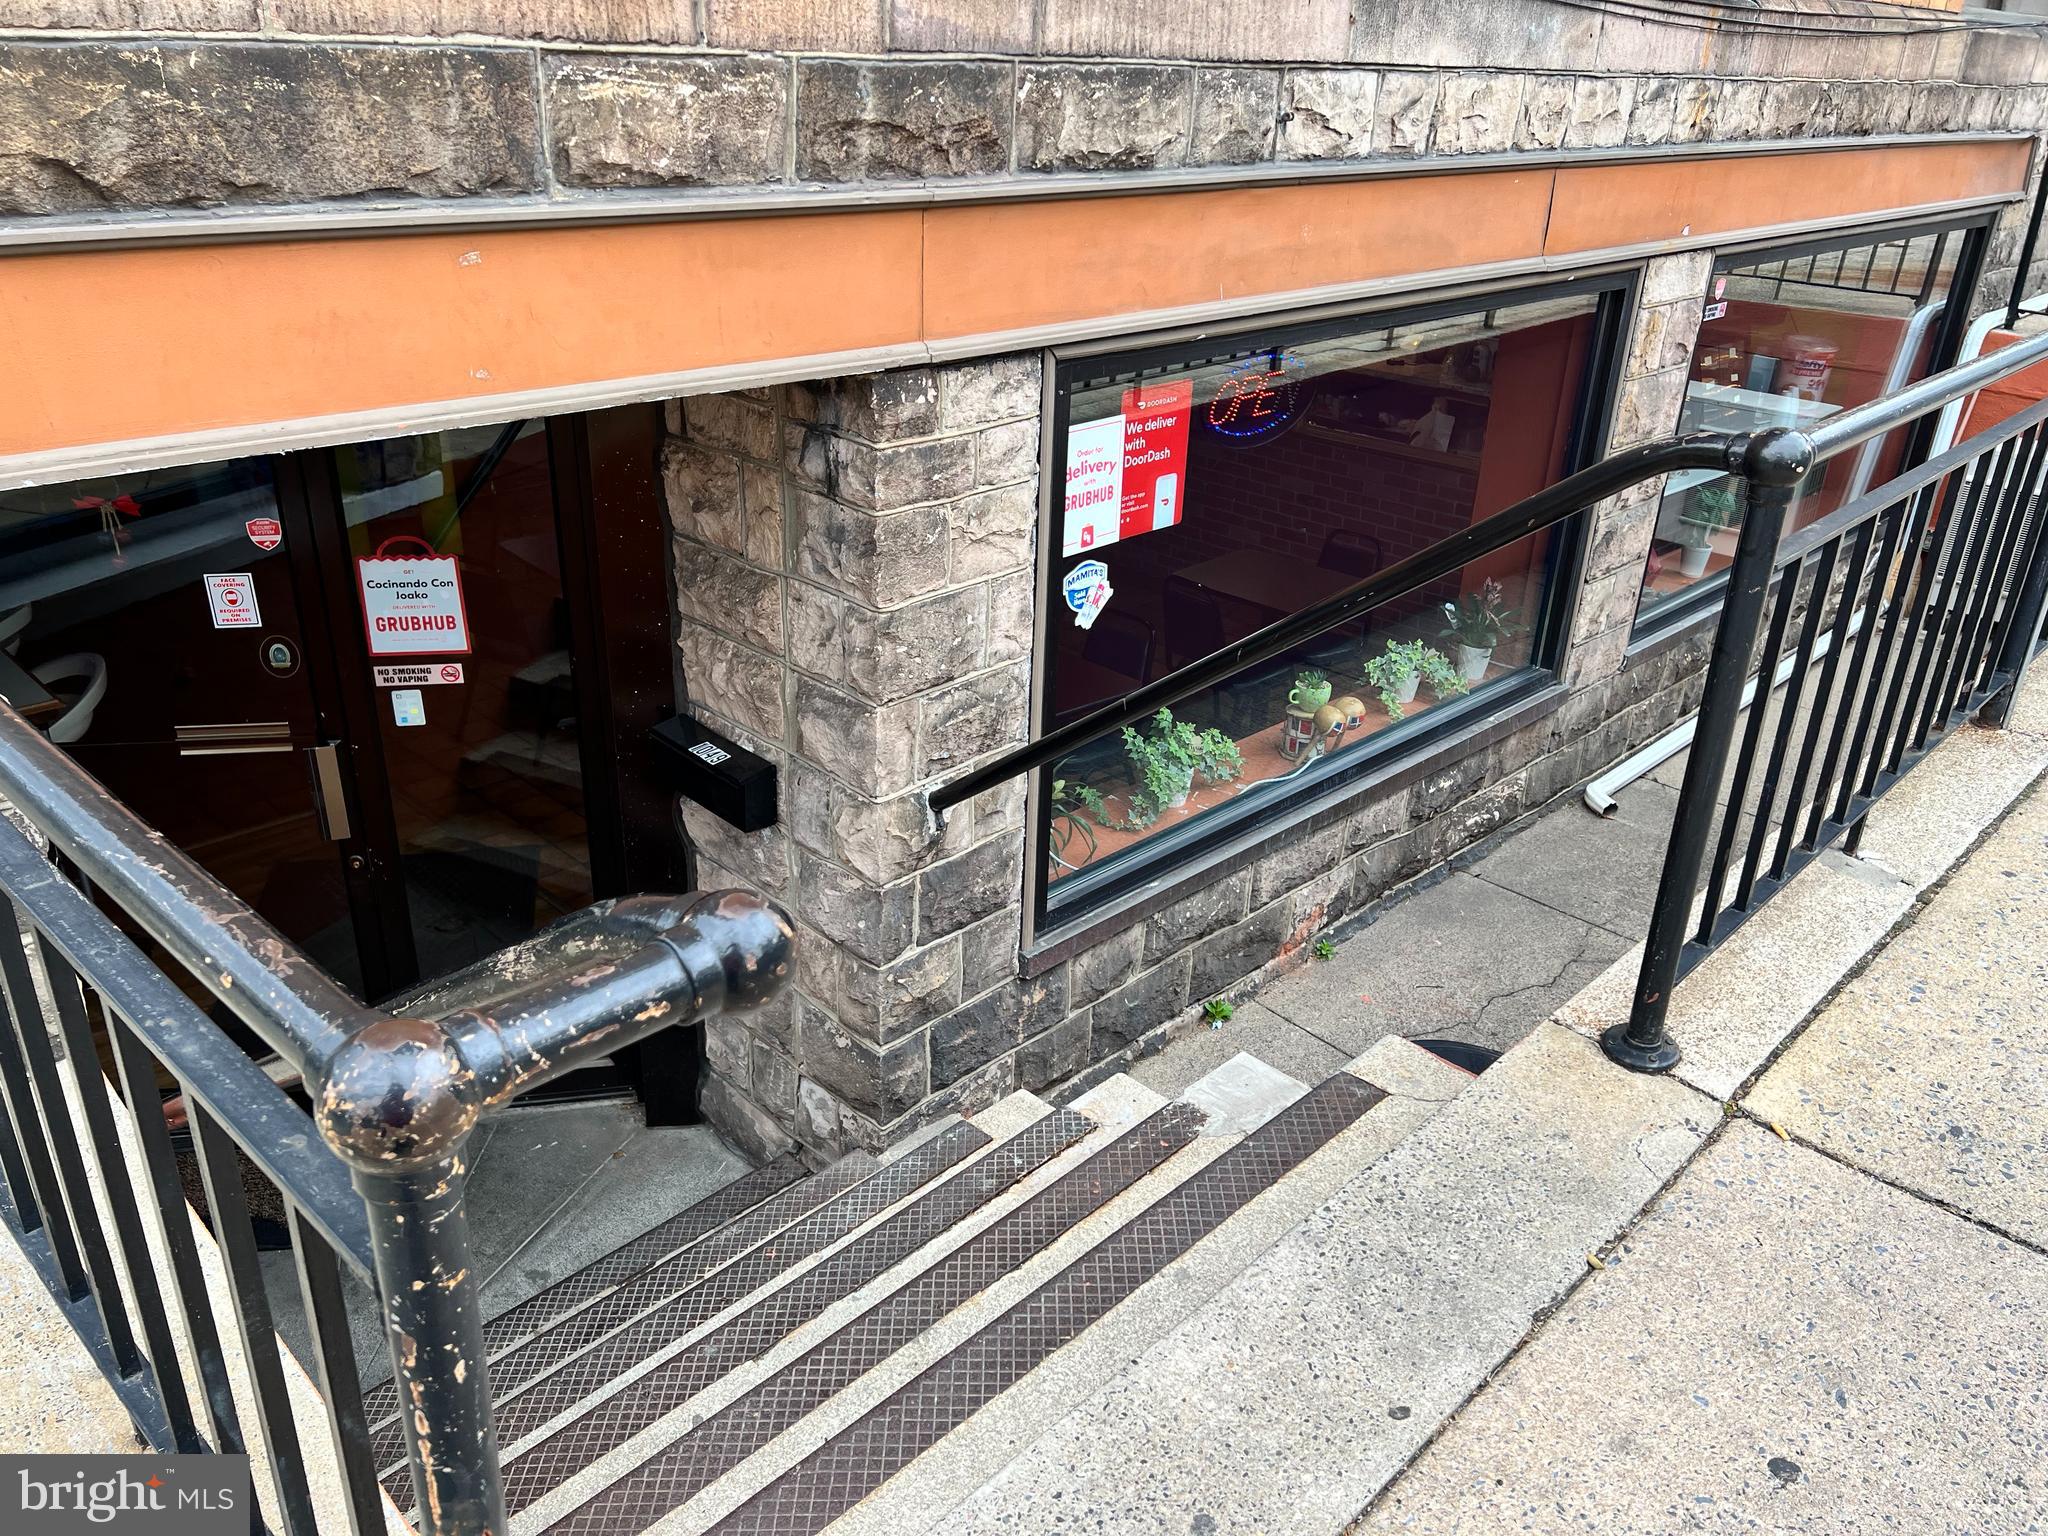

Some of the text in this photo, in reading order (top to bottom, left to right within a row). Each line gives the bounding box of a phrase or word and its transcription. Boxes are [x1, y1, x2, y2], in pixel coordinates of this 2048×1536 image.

[1147, 396, 1178, 408] DOORDASH
[1126, 416, 1177, 436] We deliver
[1125, 436, 1146, 452] with
[1124, 447, 1171, 468] DoorDash
[1066, 460, 1117, 483] delivery
[1065, 485, 1114, 512] GRUBHUB
[366, 578, 454, 589] Cocinando Con
[1068, 568, 1104, 588] MAMITA'S
[395, 591, 429, 600] Joako
[375, 615, 457, 632] GRUBHUB
[377, 667, 432, 676] NO SMOKING
[382, 675, 429, 684] NO VAPING
[689, 742, 730, 765] 1049
